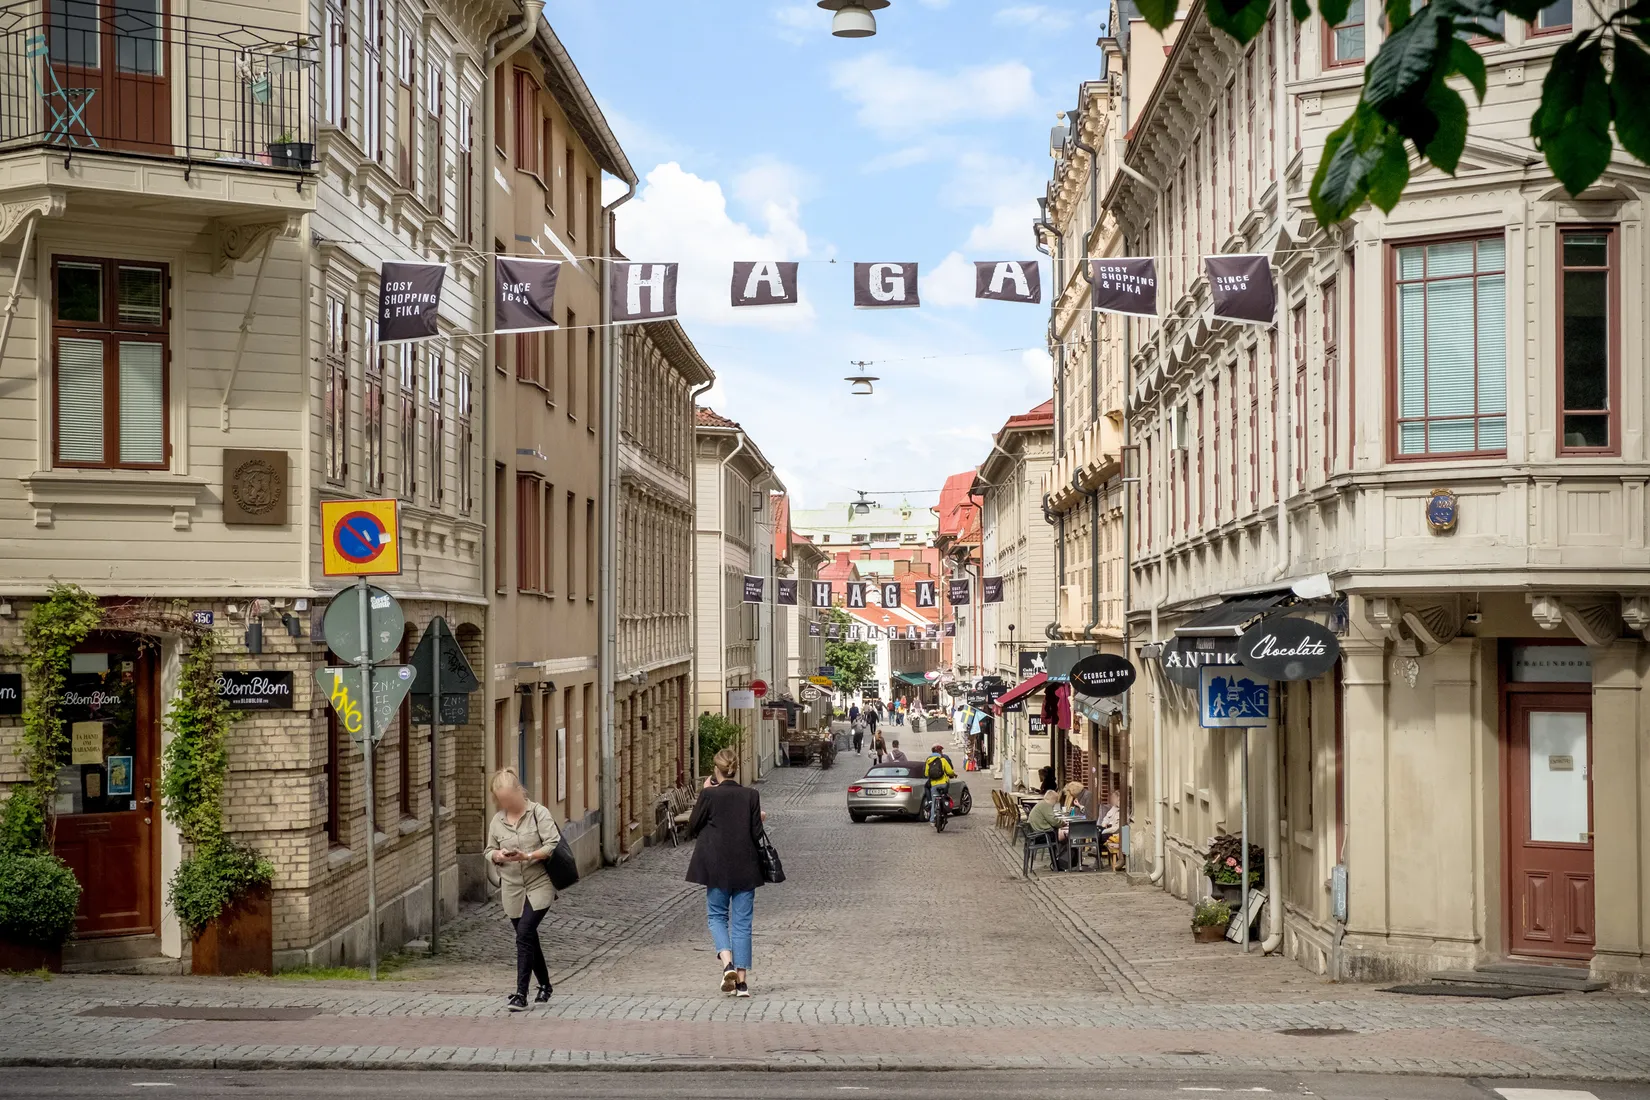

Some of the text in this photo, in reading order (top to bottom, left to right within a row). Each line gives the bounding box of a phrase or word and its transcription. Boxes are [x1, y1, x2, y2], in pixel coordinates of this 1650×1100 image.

[1101, 272, 1154, 287] SHOPPING
[1216, 274, 1250, 284] SINCE
[385, 281, 413, 292] COSY
[502, 282, 531, 294] SINCE
[1102, 280, 1141, 295] & FIKA
[1218, 282, 1247, 292] 1648
[384, 293, 437, 306] SHOPPING
[384, 305, 420, 319] & FIKA
[195, 612, 211, 624] 35C
[1250, 634, 1327, 660] Chocolate
[1165, 651, 1238, 668] ANTIK
[1083, 671, 1107, 680] GEORGE
[1116, 669, 1129, 677] SON
[215, 677, 289, 696] BlomBlom
[64, 691, 121, 709] BlomBlom
[1030, 717, 1042, 725] VILL
